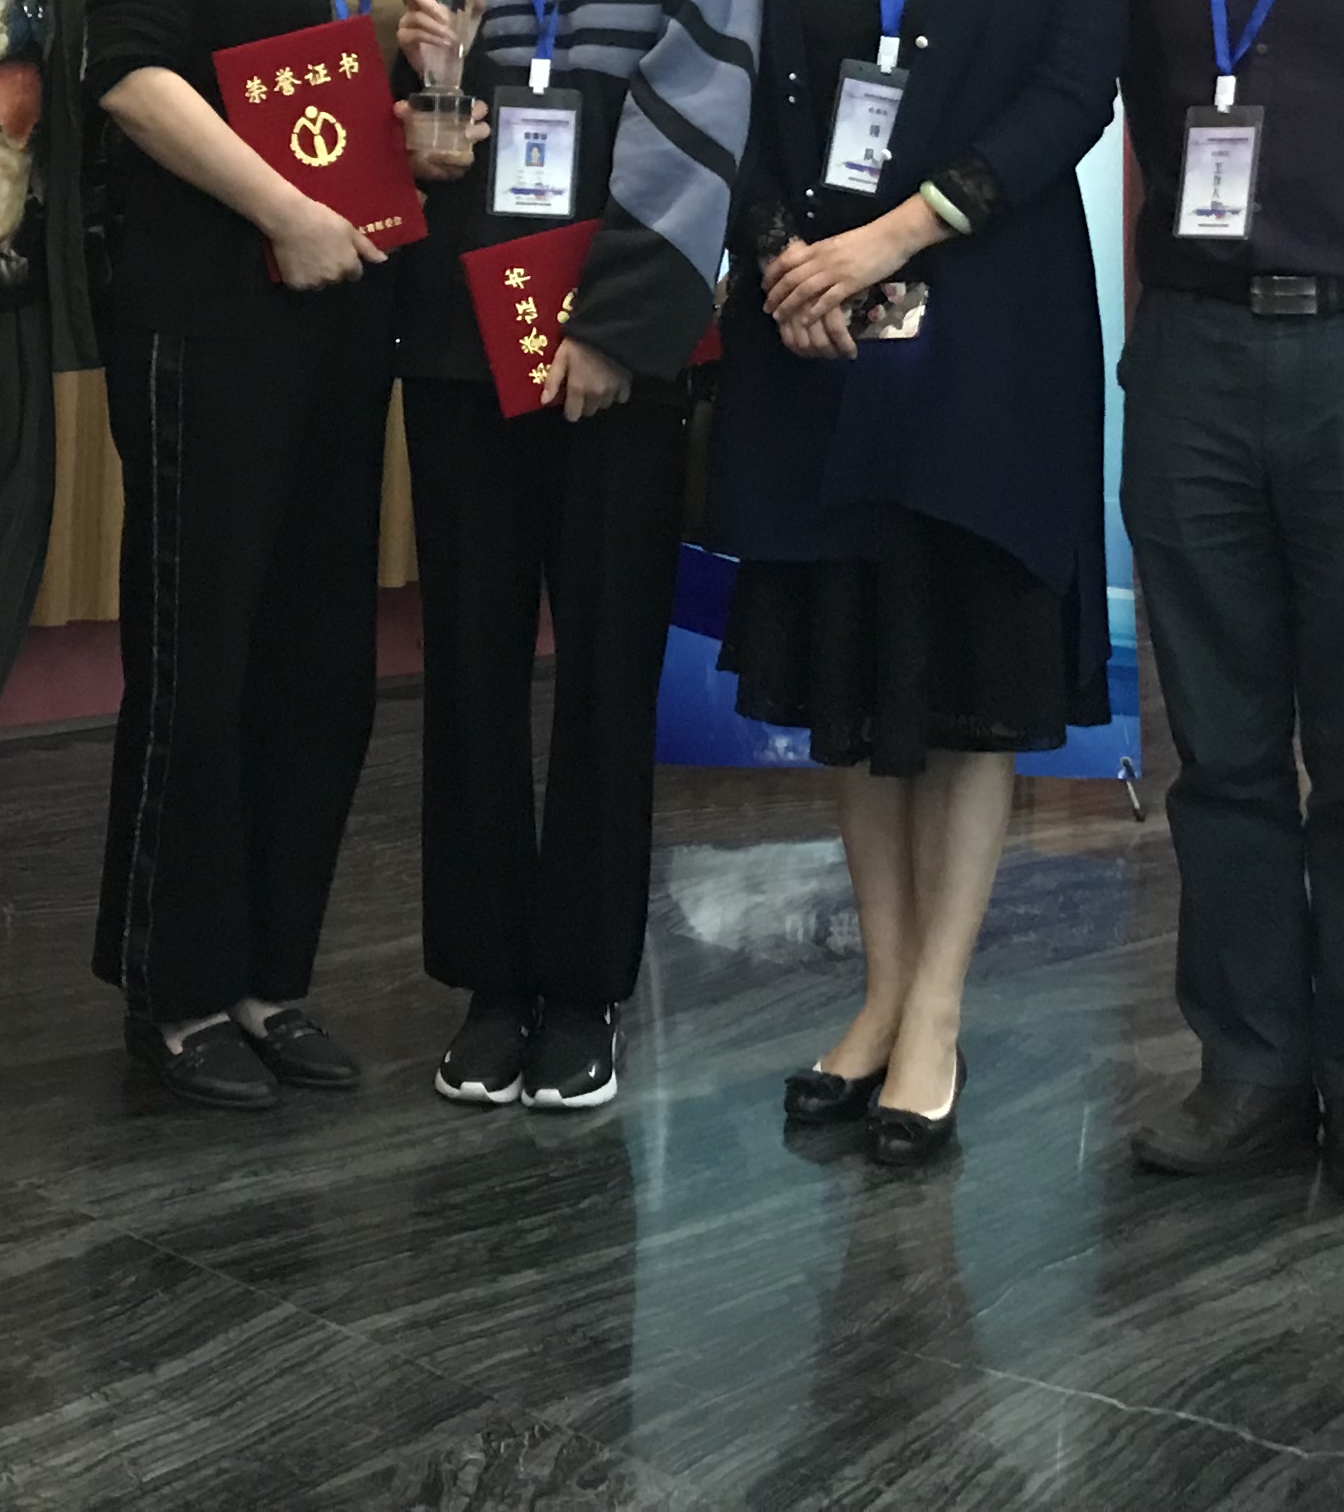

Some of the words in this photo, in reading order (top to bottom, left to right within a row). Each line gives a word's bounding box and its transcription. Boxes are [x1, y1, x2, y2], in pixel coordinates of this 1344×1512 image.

[244, 52, 361, 104] 荣誉证书
[504, 267, 552, 385] 荣誉证书
